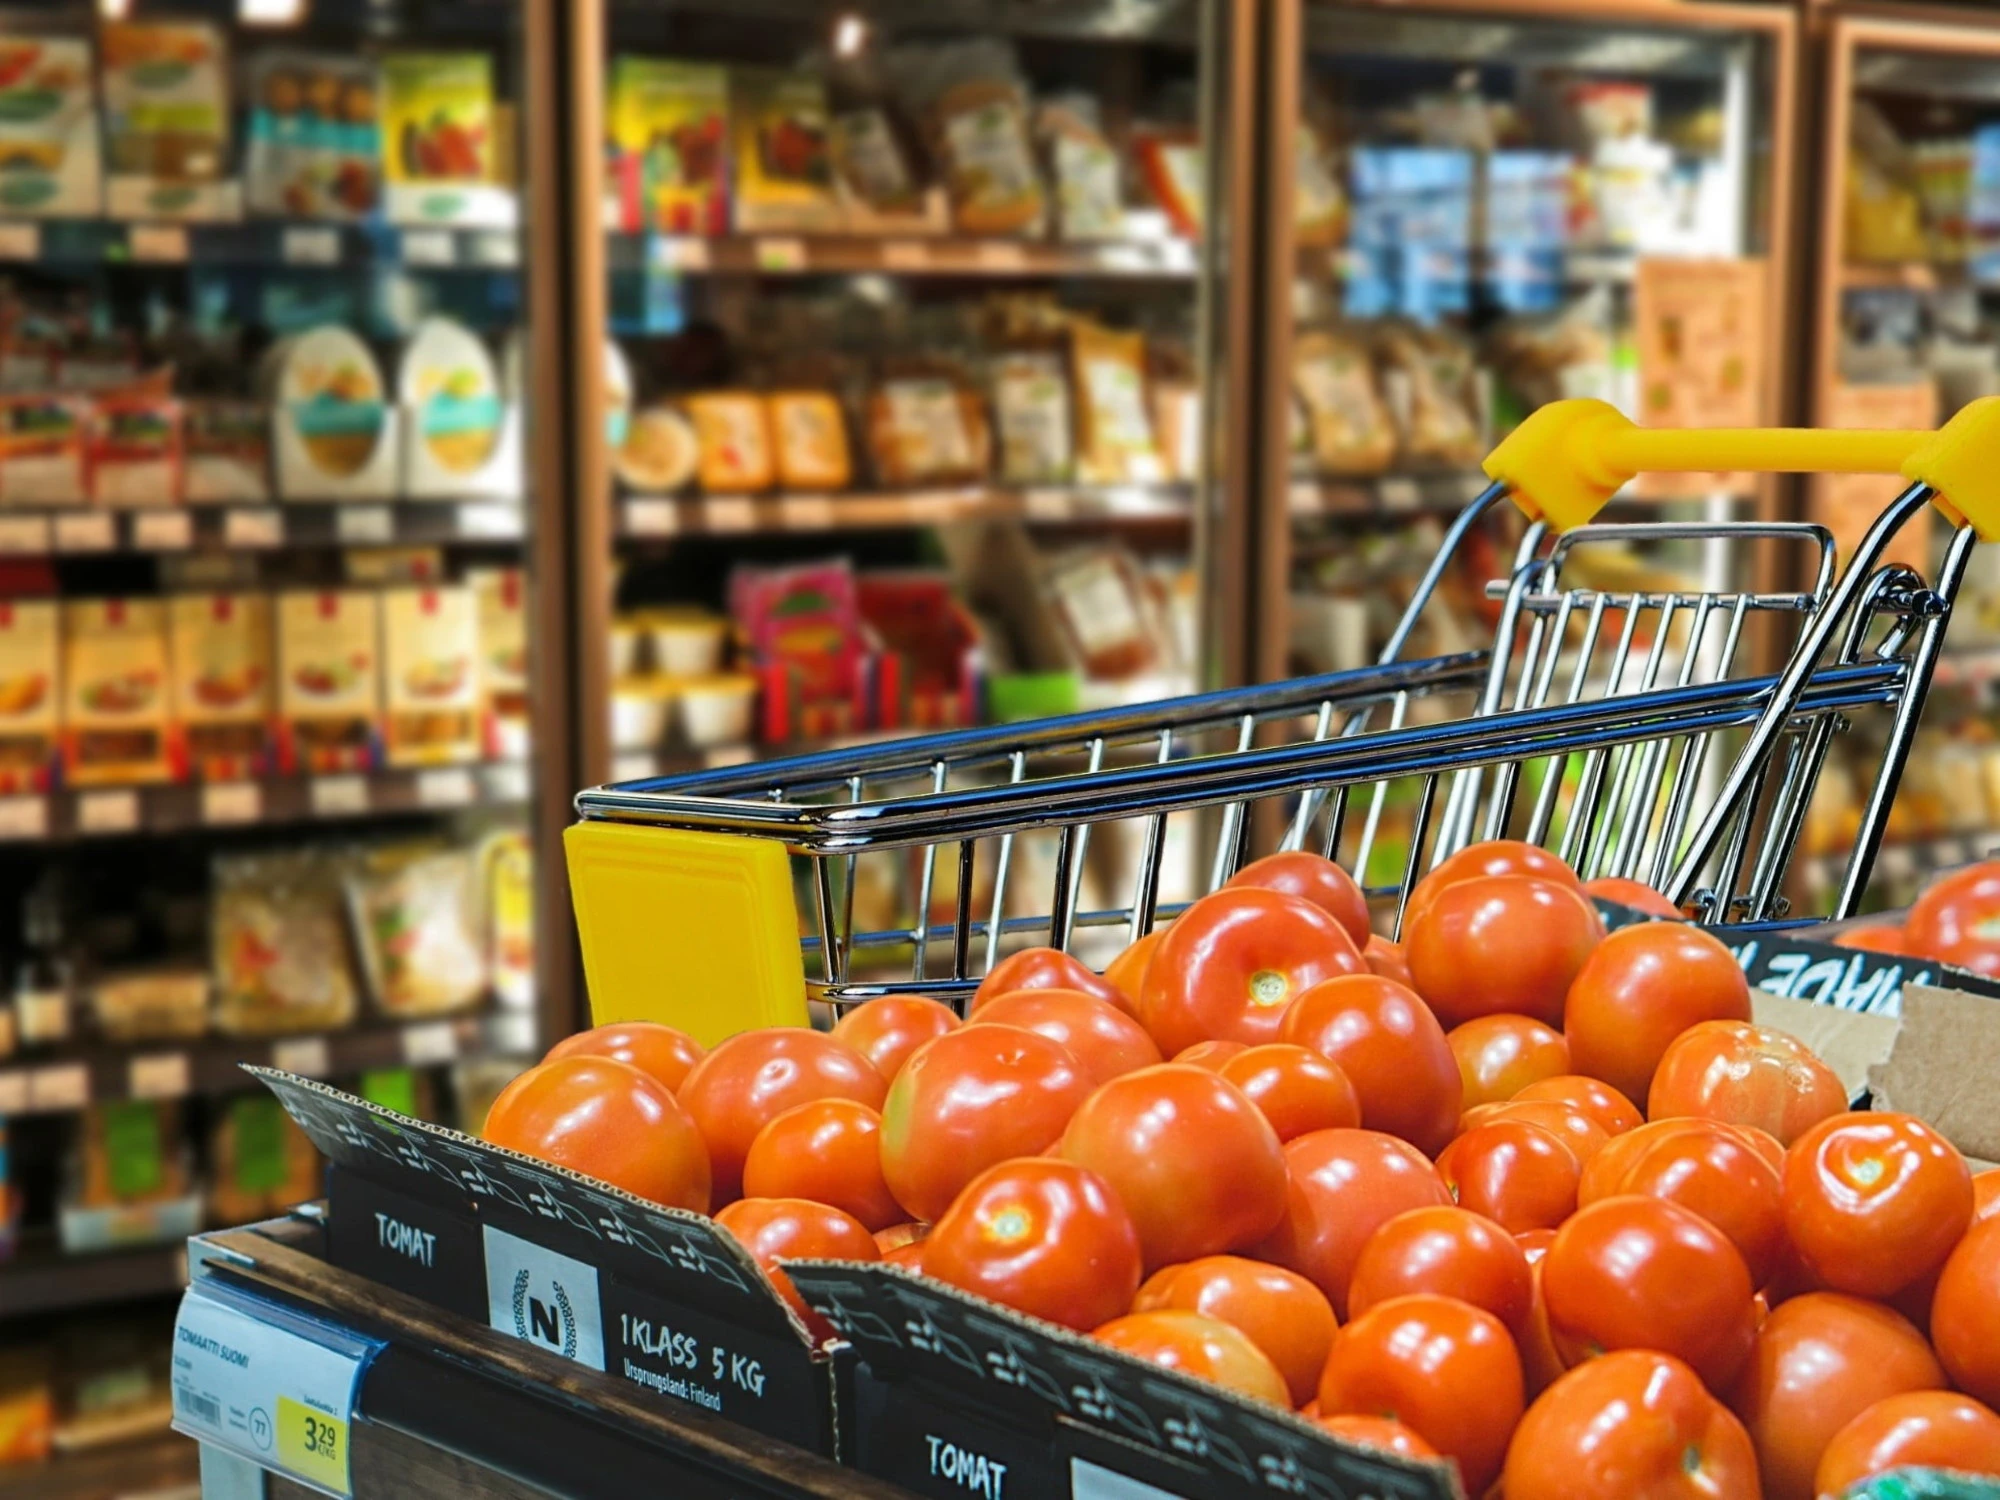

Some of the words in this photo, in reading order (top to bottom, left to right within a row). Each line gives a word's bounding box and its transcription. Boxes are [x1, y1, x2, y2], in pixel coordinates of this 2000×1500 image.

[375, 1212, 436, 1268] TOMAT
[178, 1325, 220, 1357] TOMAATTI
[220, 1344, 250, 1369] SUOMI
[528, 1296, 560, 1346] N
[623, 1356, 689, 1400] Ursprungsland:
[689, 1381, 721, 1412] Finland
[632, 1316, 698, 1370] KLASS
[712, 1347, 725, 1380] 5
[732, 1353, 766, 1397] KG
[254, 1418, 267, 1437] 77
[925, 1433, 1007, 1500] TOMAT
